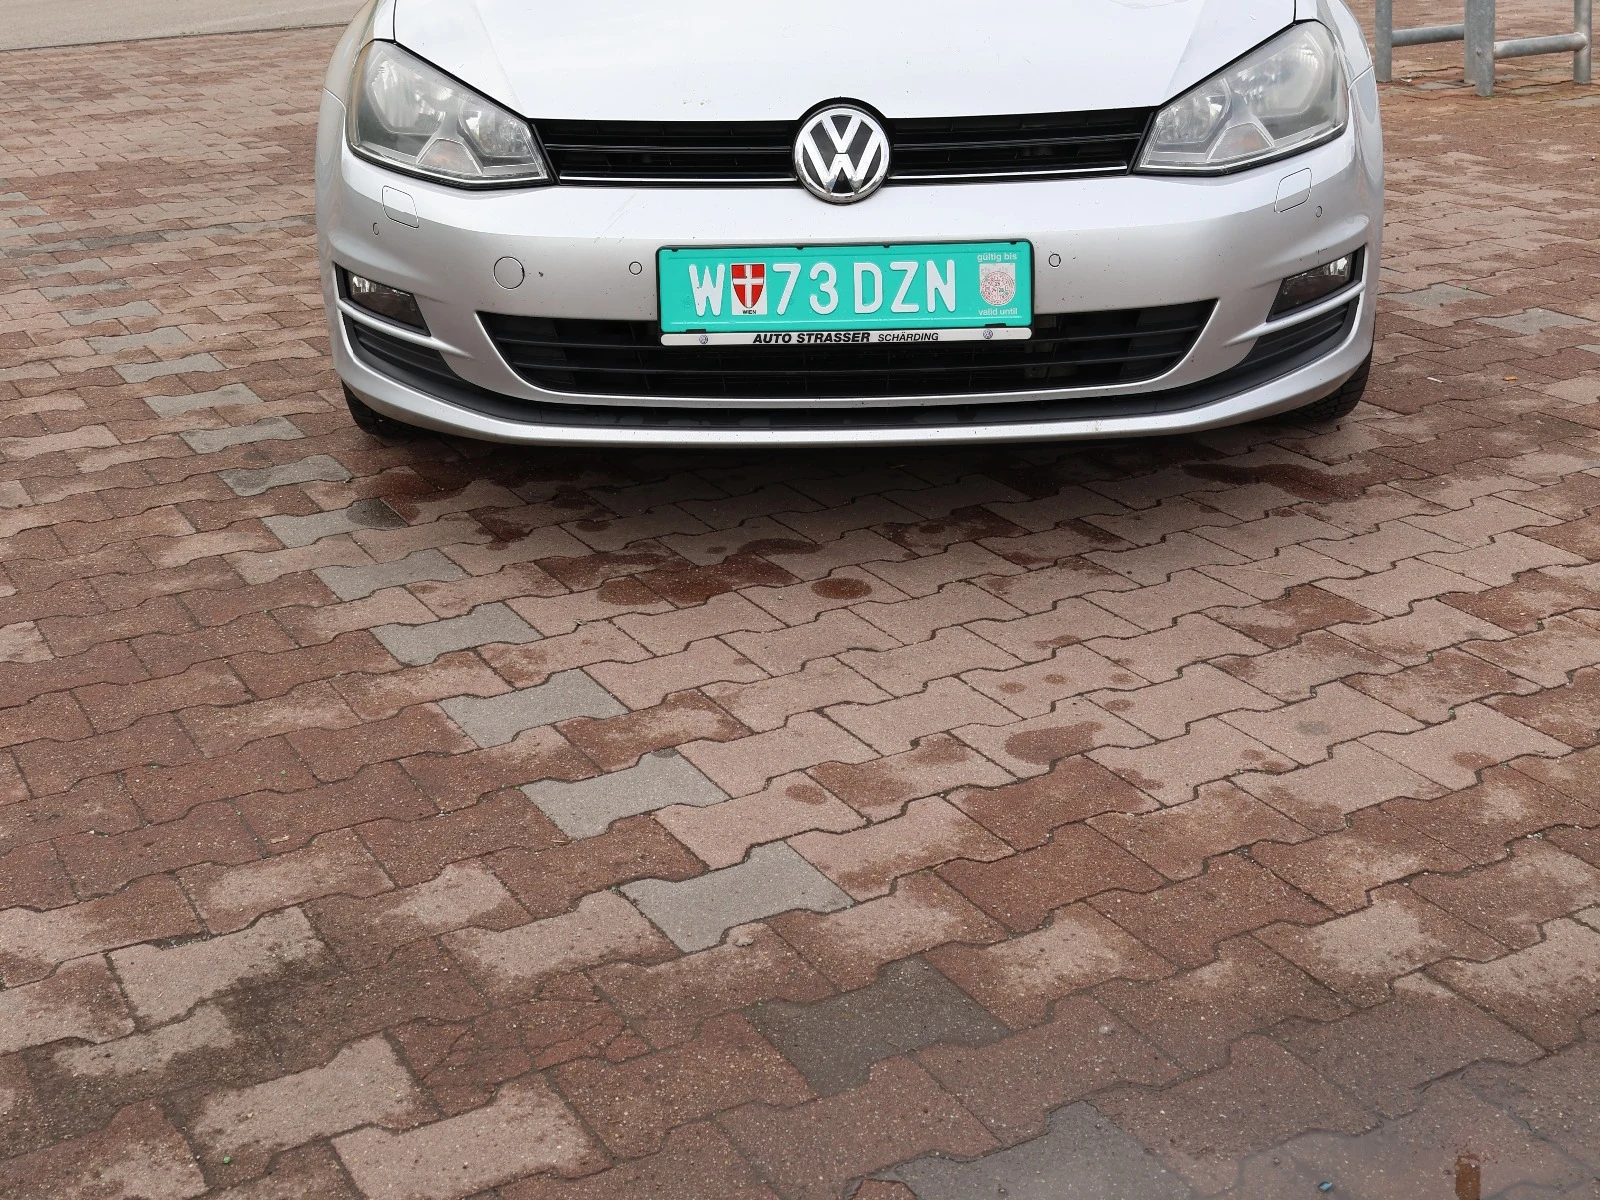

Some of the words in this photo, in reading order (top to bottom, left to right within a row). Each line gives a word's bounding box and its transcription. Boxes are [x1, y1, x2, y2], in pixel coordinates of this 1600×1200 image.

[976, 252, 1002, 263] gültig
[1003, 252, 1018, 261] bis
[688, 263, 726, 317] W
[978, 307, 998, 316] valid
[999, 307, 1018, 315] until
[752, 333, 792, 344] AUTO
[796, 331, 871, 344] STRASSER
[877, 331, 940, 342] SCHÄRDING
